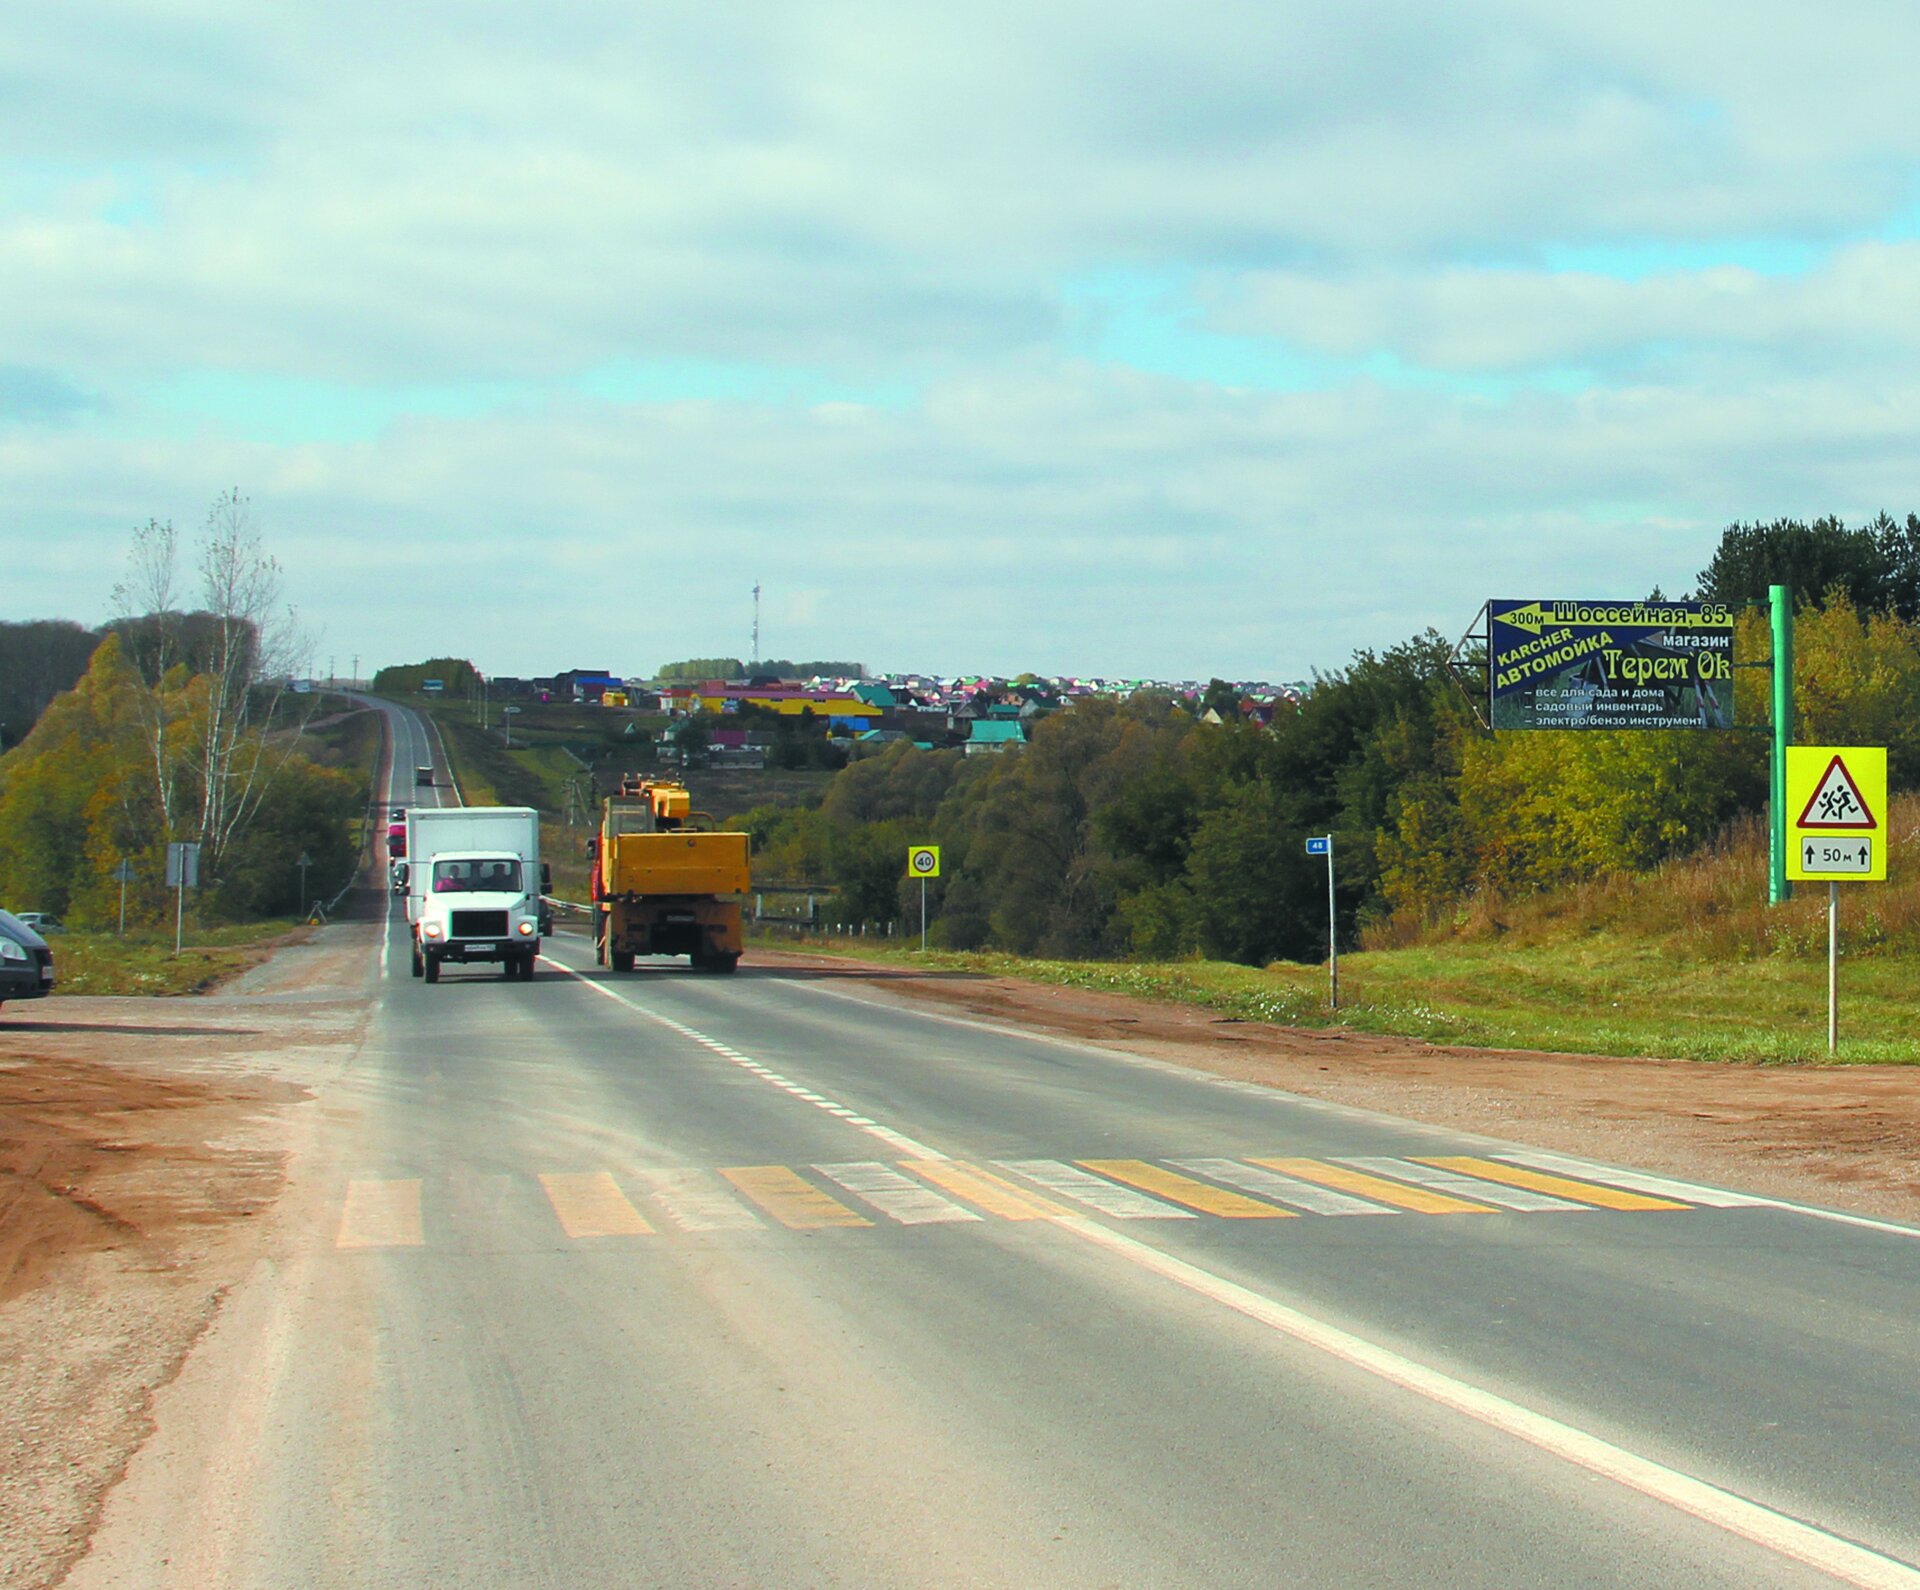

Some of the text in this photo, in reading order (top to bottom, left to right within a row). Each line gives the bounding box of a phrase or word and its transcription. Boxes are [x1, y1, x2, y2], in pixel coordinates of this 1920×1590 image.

[1553, 602, 1727, 627] Шоссейная, 85
[1497, 627, 1573, 667] KARCHER
[1663, 635, 1729, 648] магазин
[1497, 631, 1614, 689] АВТОМОЙКА
[1535, 689, 1665, 698] все для сада и дома
[1535, 702, 1663, 713] садовый инвентарь
[1535, 715, 1702, 728] электро/бензо инструмент
[917, 857, 931, 866] 40
